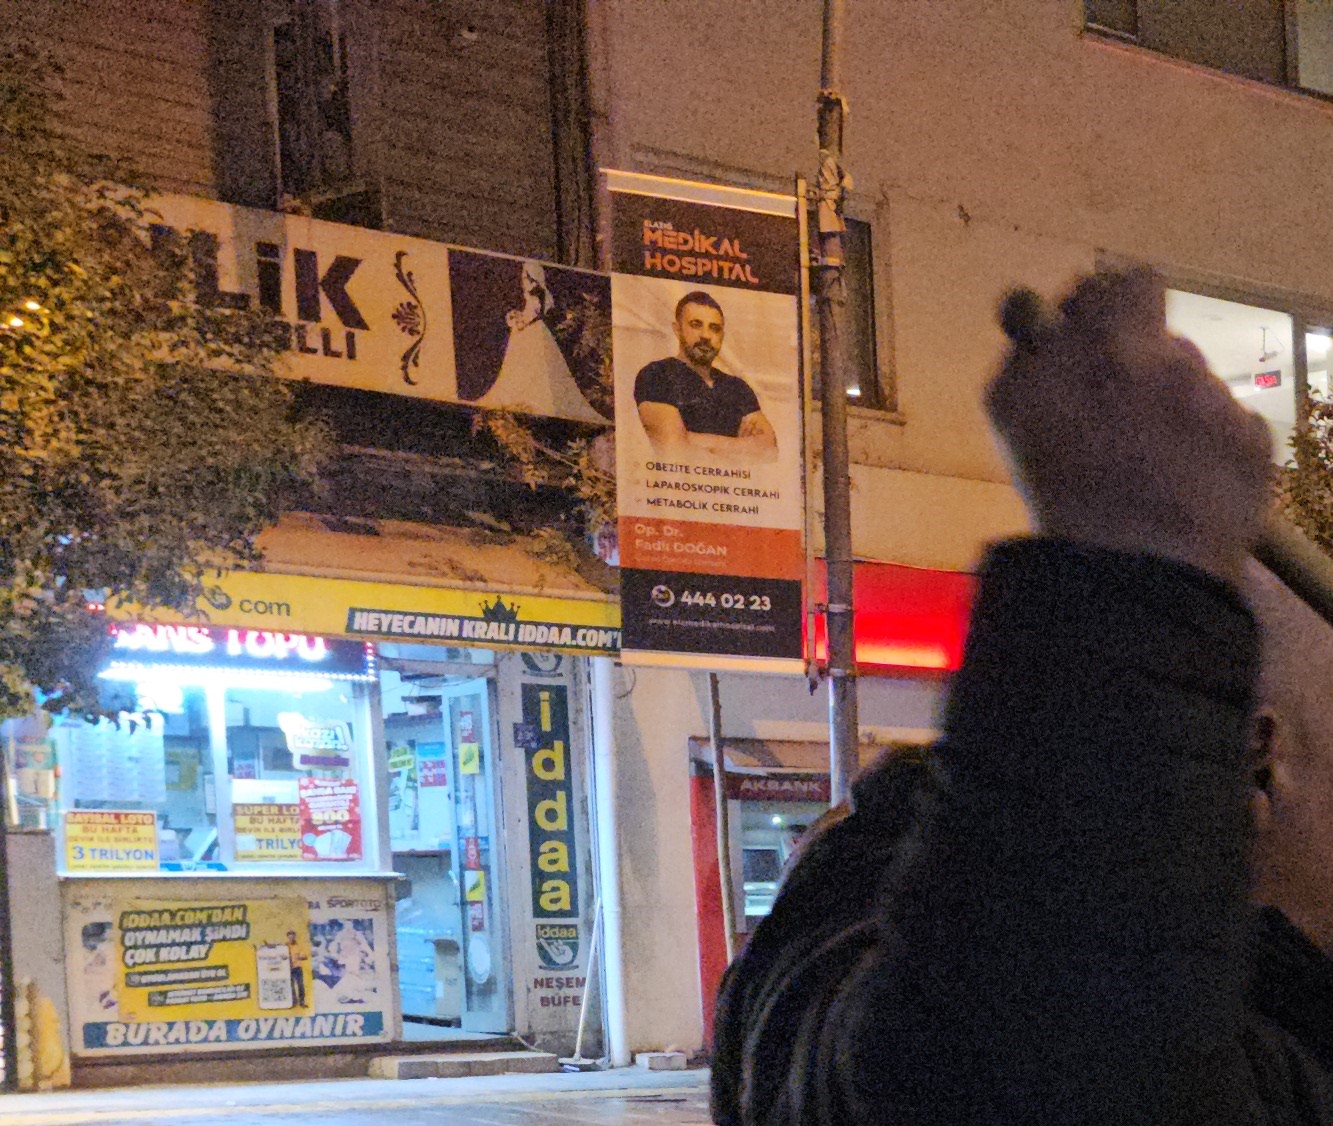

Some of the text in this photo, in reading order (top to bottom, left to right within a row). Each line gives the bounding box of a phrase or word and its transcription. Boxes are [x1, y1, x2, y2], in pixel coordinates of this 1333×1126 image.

[643, 228, 748, 259] MEDİKAL
[644, 251, 759, 284] HOSPITAL
[634, 523, 684, 537] Op. Dr.
[673, 541, 727, 556] DOĞAN
[239, 599, 291, 616] com
[680, 590, 772, 611] 444 02 23
[354, 611, 461, 637] HEYECANIN
[462, 619, 516, 641] KRALI
[740, 779, 823, 792] AKBANK
[119, 813, 155, 825] LOTO
[249, 816, 264, 825] BU
[82, 825, 139, 835] BU HAFTA
[73, 845, 155, 861] 3 TRİLYON
[537, 924, 577, 939] iddaa
[103, 1013, 365, 1046] BURADA OYNANIR
